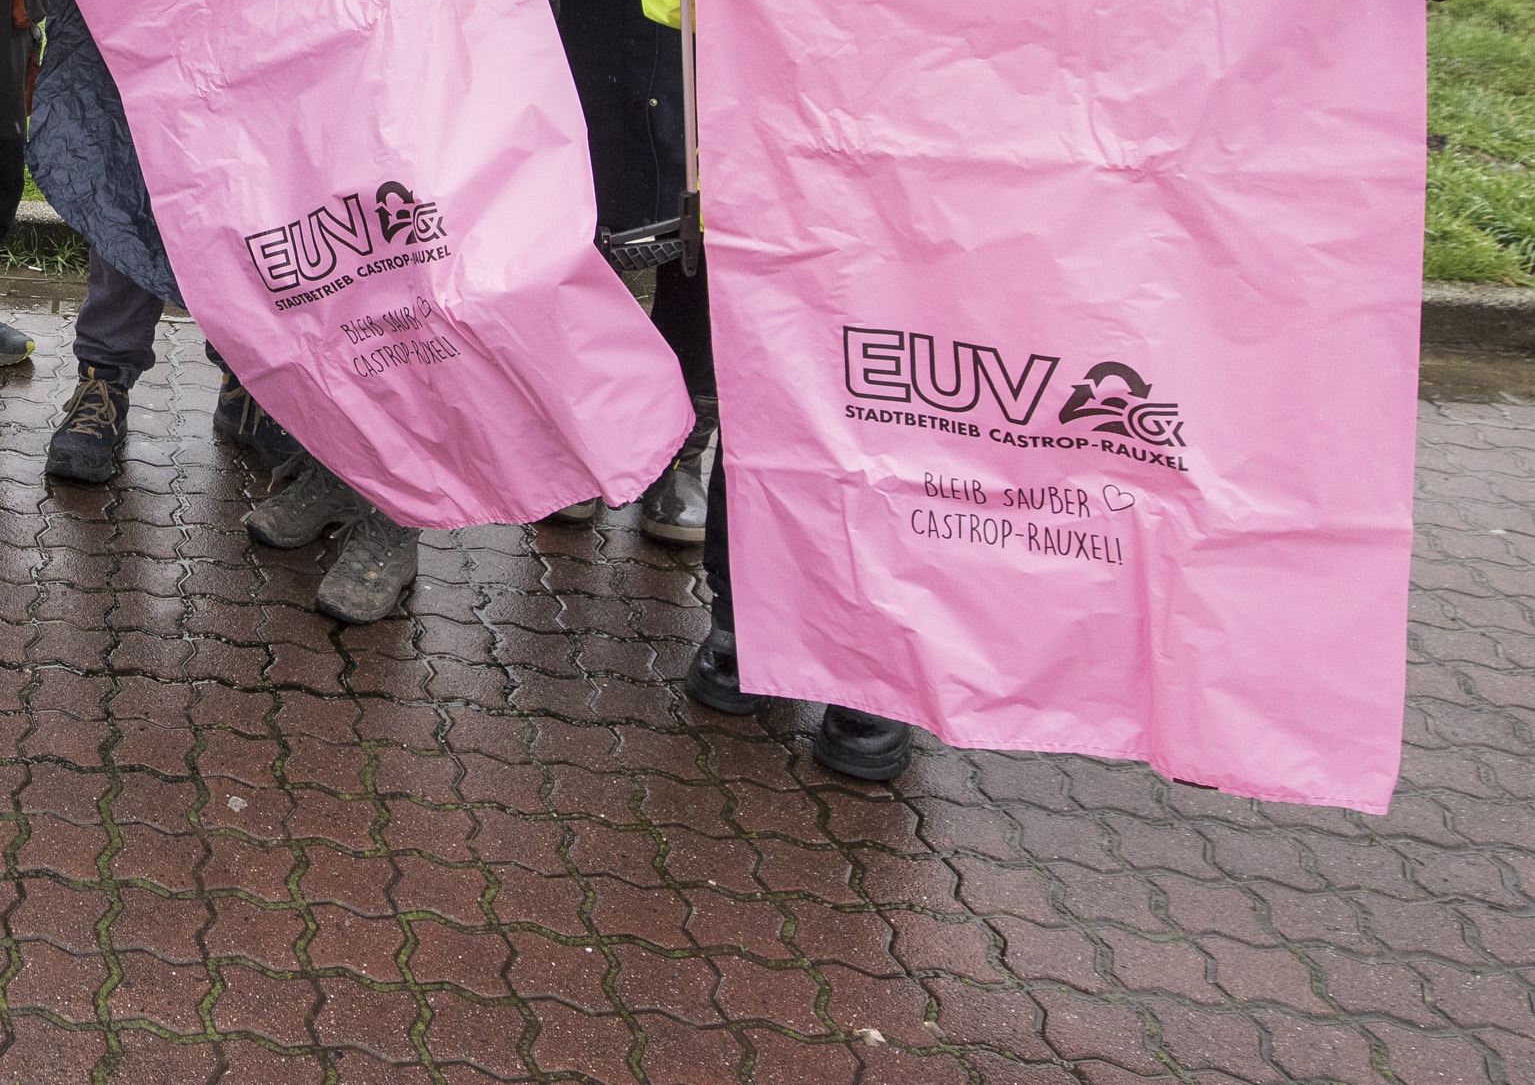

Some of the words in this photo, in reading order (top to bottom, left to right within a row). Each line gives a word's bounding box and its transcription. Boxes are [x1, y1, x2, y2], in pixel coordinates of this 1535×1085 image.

[244, 193, 374, 293] EUV
[275, 275, 354, 311] STADTBETRIEB
[340, 315, 384, 345] BLEIB
[843, 325, 1061, 425] EUV
[845, 404, 981, 437] STADTBETRIEB
[989, 428, 1189, 471] CASTROP-RAUXEL
[924, 471, 987, 505] BLEIB
[1003, 486, 1091, 518] SAUBER
[911, 509, 1124, 566] CASTROP-RAUXEL!
